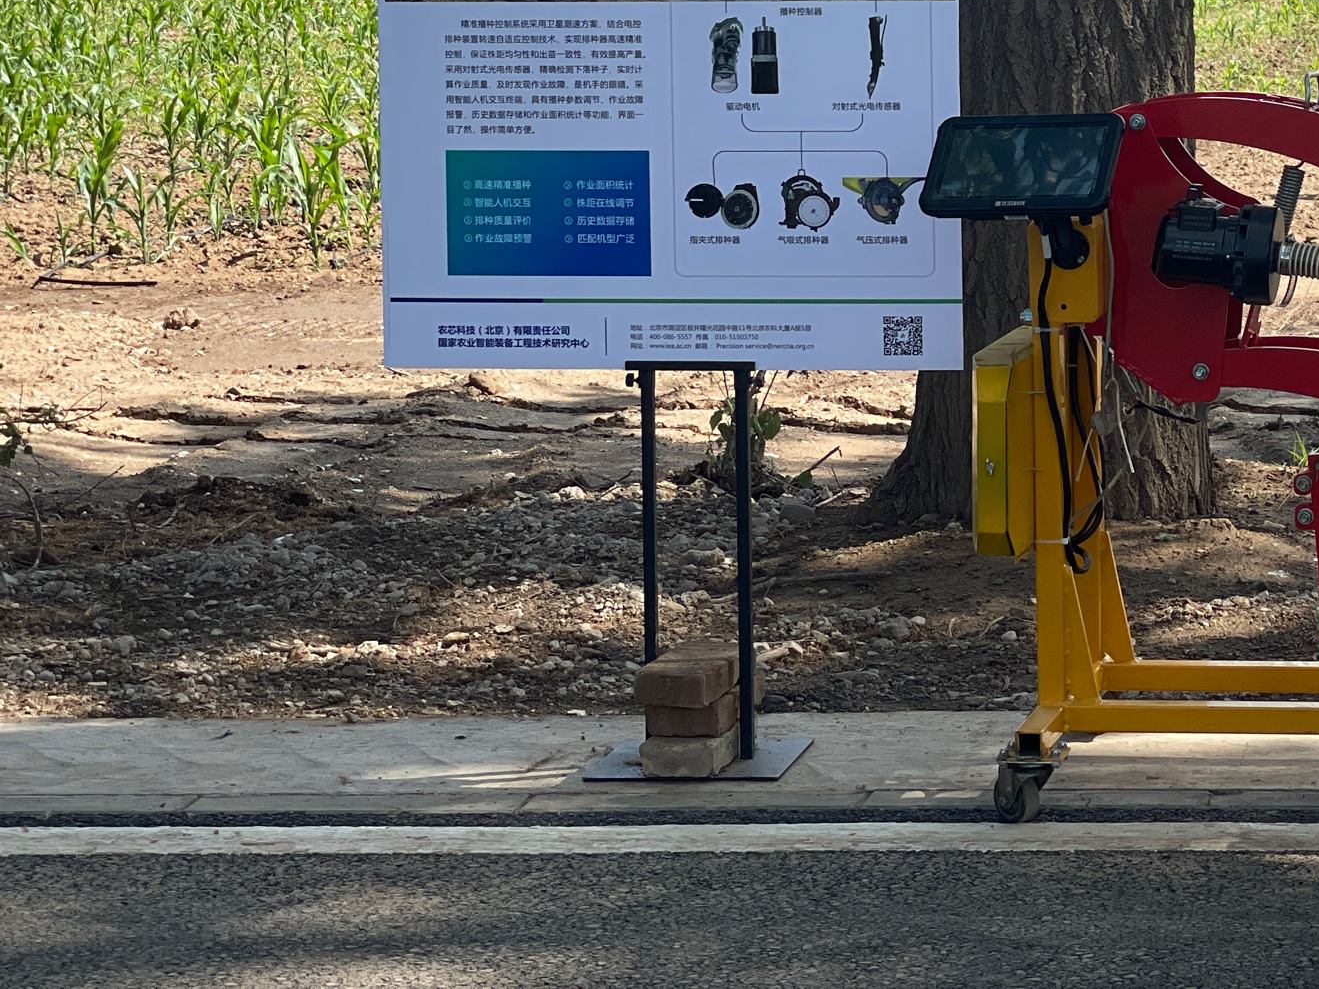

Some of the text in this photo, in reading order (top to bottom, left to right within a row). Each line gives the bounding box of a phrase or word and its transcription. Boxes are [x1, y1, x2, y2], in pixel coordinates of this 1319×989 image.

[779, 7, 823, 16] 播种控制器
[725, 102, 761, 111] 驱动电机
[831, 102, 901, 111] 对射式光电传感器
[446, 125, 536, 135] 目了然，操作简单方便。
[474, 179, 532, 190] 高速精准播种
[576, 179, 635, 190] 作业面积统计
[474, 197, 532, 208] 智能人机交互
[576, 198, 635, 208] 株距在线调节
[474, 215, 532, 226] 排种质量评价
[576, 216, 635, 226] 历史数据存储
[474, 233, 533, 244] 作业故障预警
[577, 233, 635, 244] 匹配机型广泛
[689, 235, 741, 245] 指夹式排种器
[777, 235, 829, 245] 气吸式排种器
[856, 235, 908, 245] 气压式排种器
[437, 338, 590, 348] 国家农业智能装备工程技术研究中心
